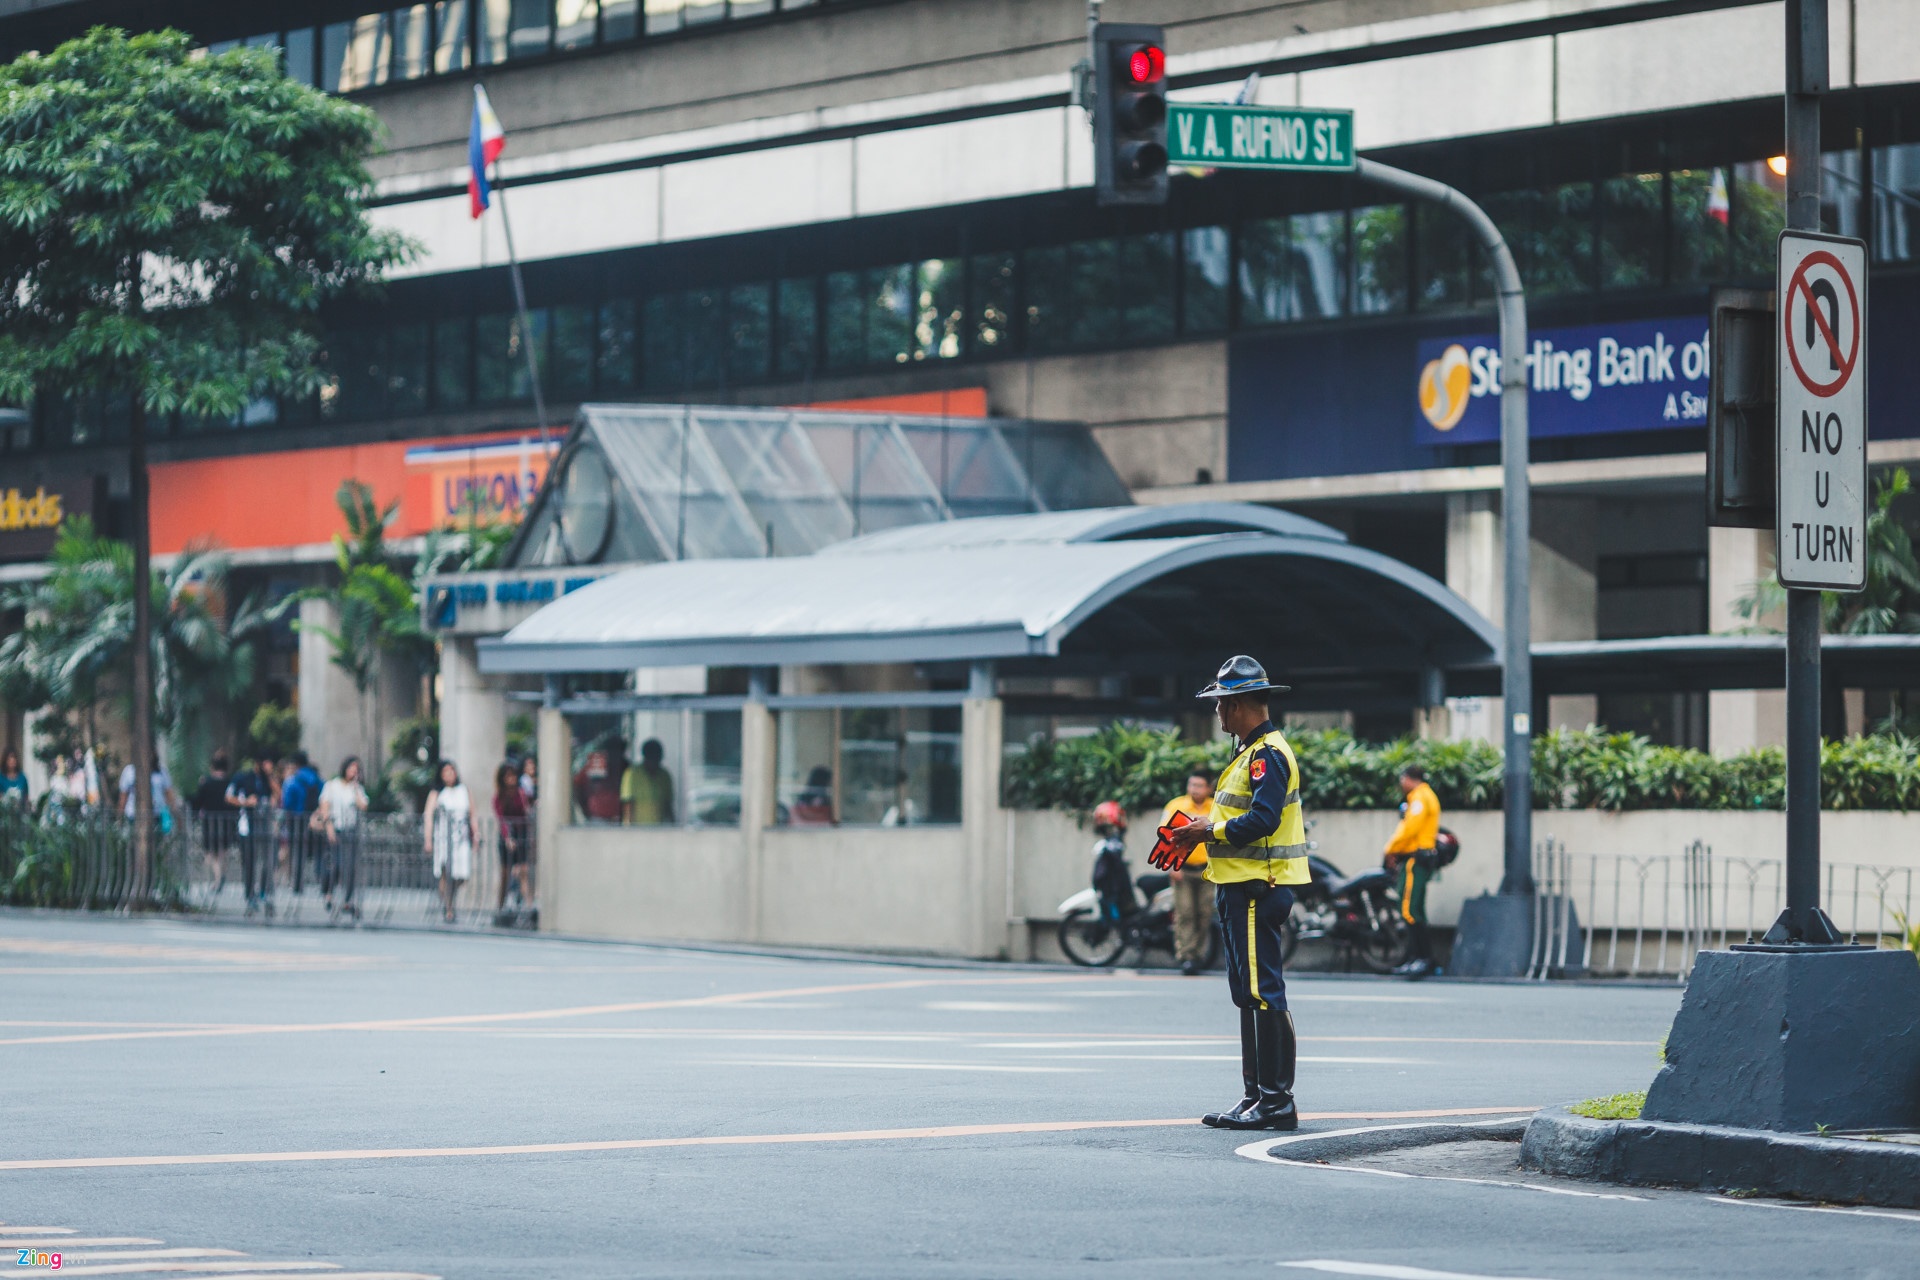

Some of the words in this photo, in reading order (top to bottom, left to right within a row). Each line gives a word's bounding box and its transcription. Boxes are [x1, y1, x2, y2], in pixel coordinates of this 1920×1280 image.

[1177, 113, 1197, 155] V.
[1203, 114, 1225, 157] A.
[1231, 115, 1308, 161] RUFINO
[1313, 118, 1344, 162] ST.
[1599, 331, 1676, 387] Bank
[1662, 392, 1679, 420] A
[1802, 410, 1843, 455] NO
[1815, 470, 1829, 508] U
[1792, 522, 1853, 563] TURN
